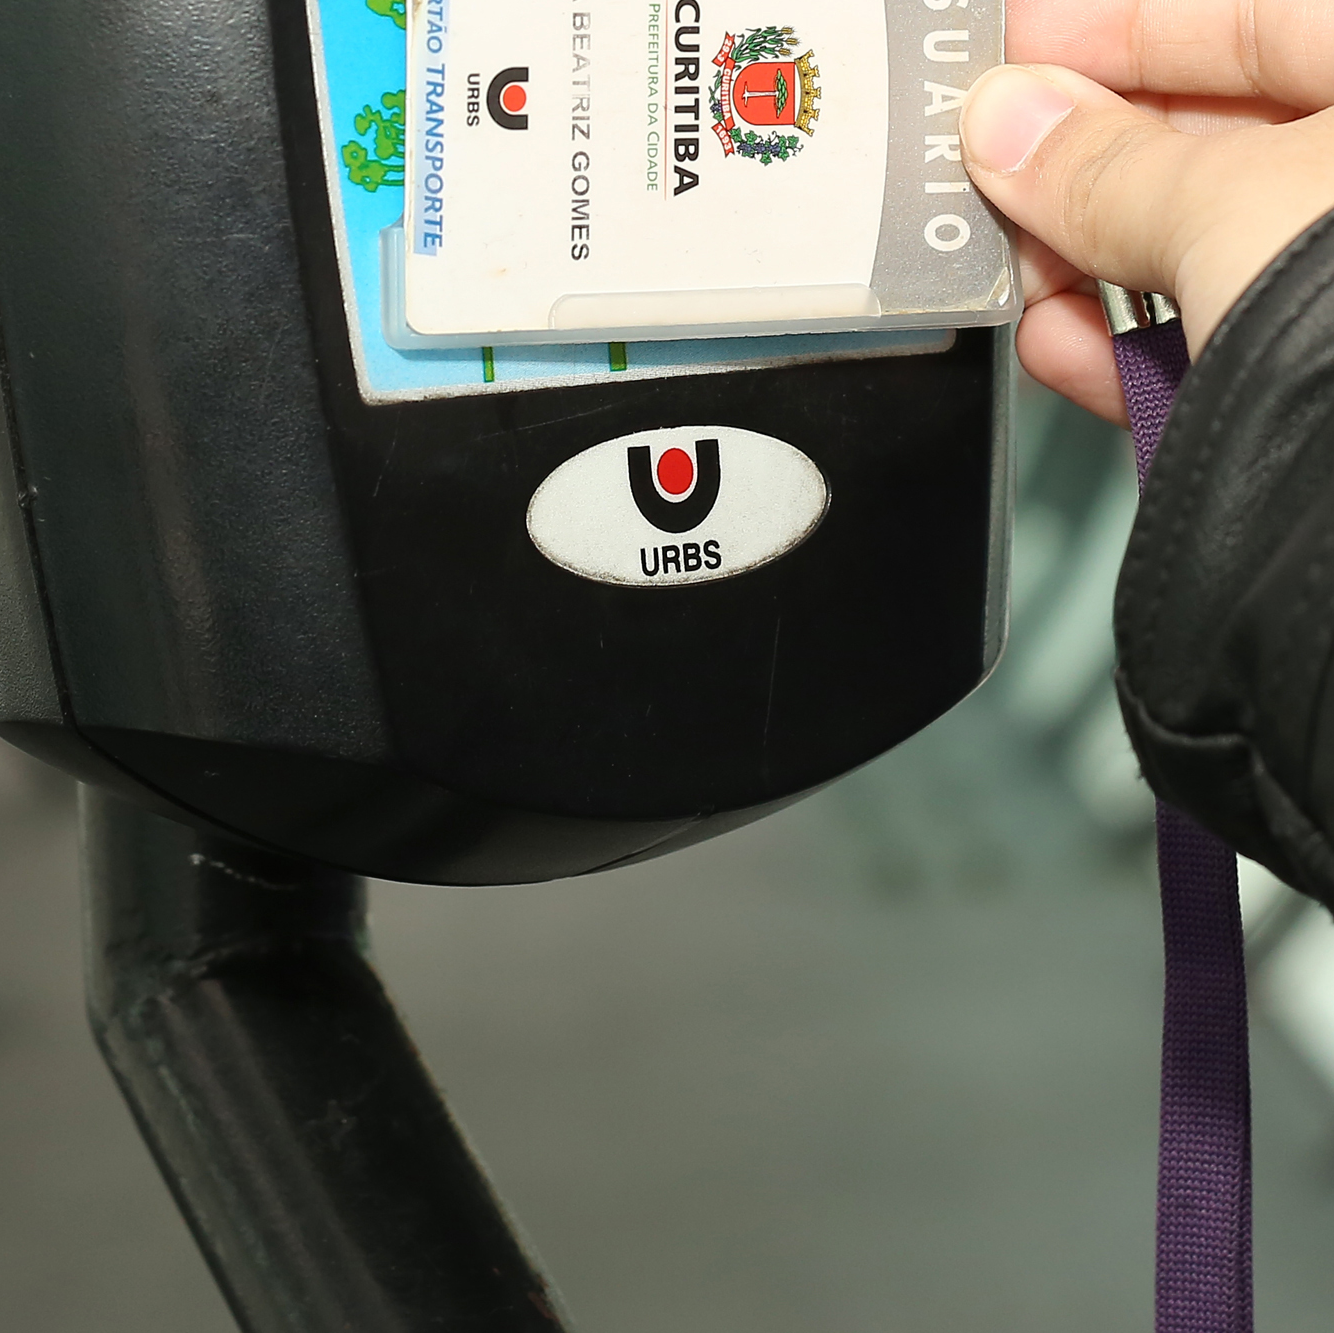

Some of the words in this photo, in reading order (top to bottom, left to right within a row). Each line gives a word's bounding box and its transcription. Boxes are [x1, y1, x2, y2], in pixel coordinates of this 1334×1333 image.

[571, 12, 592, 141] BEATRIZ
[647, 3, 661, 97] PREFEITURA
[467, 73, 481, 127] URBS
[647, 103, 659, 126] DA
[721, 68, 732, 120] CURITIBA
[423, 63, 446, 248] TRANSPORTE
[647, 131, 660, 191] CIDADE
[571, 151, 591, 261] GOMES
[640, 539, 722, 578] URBS
